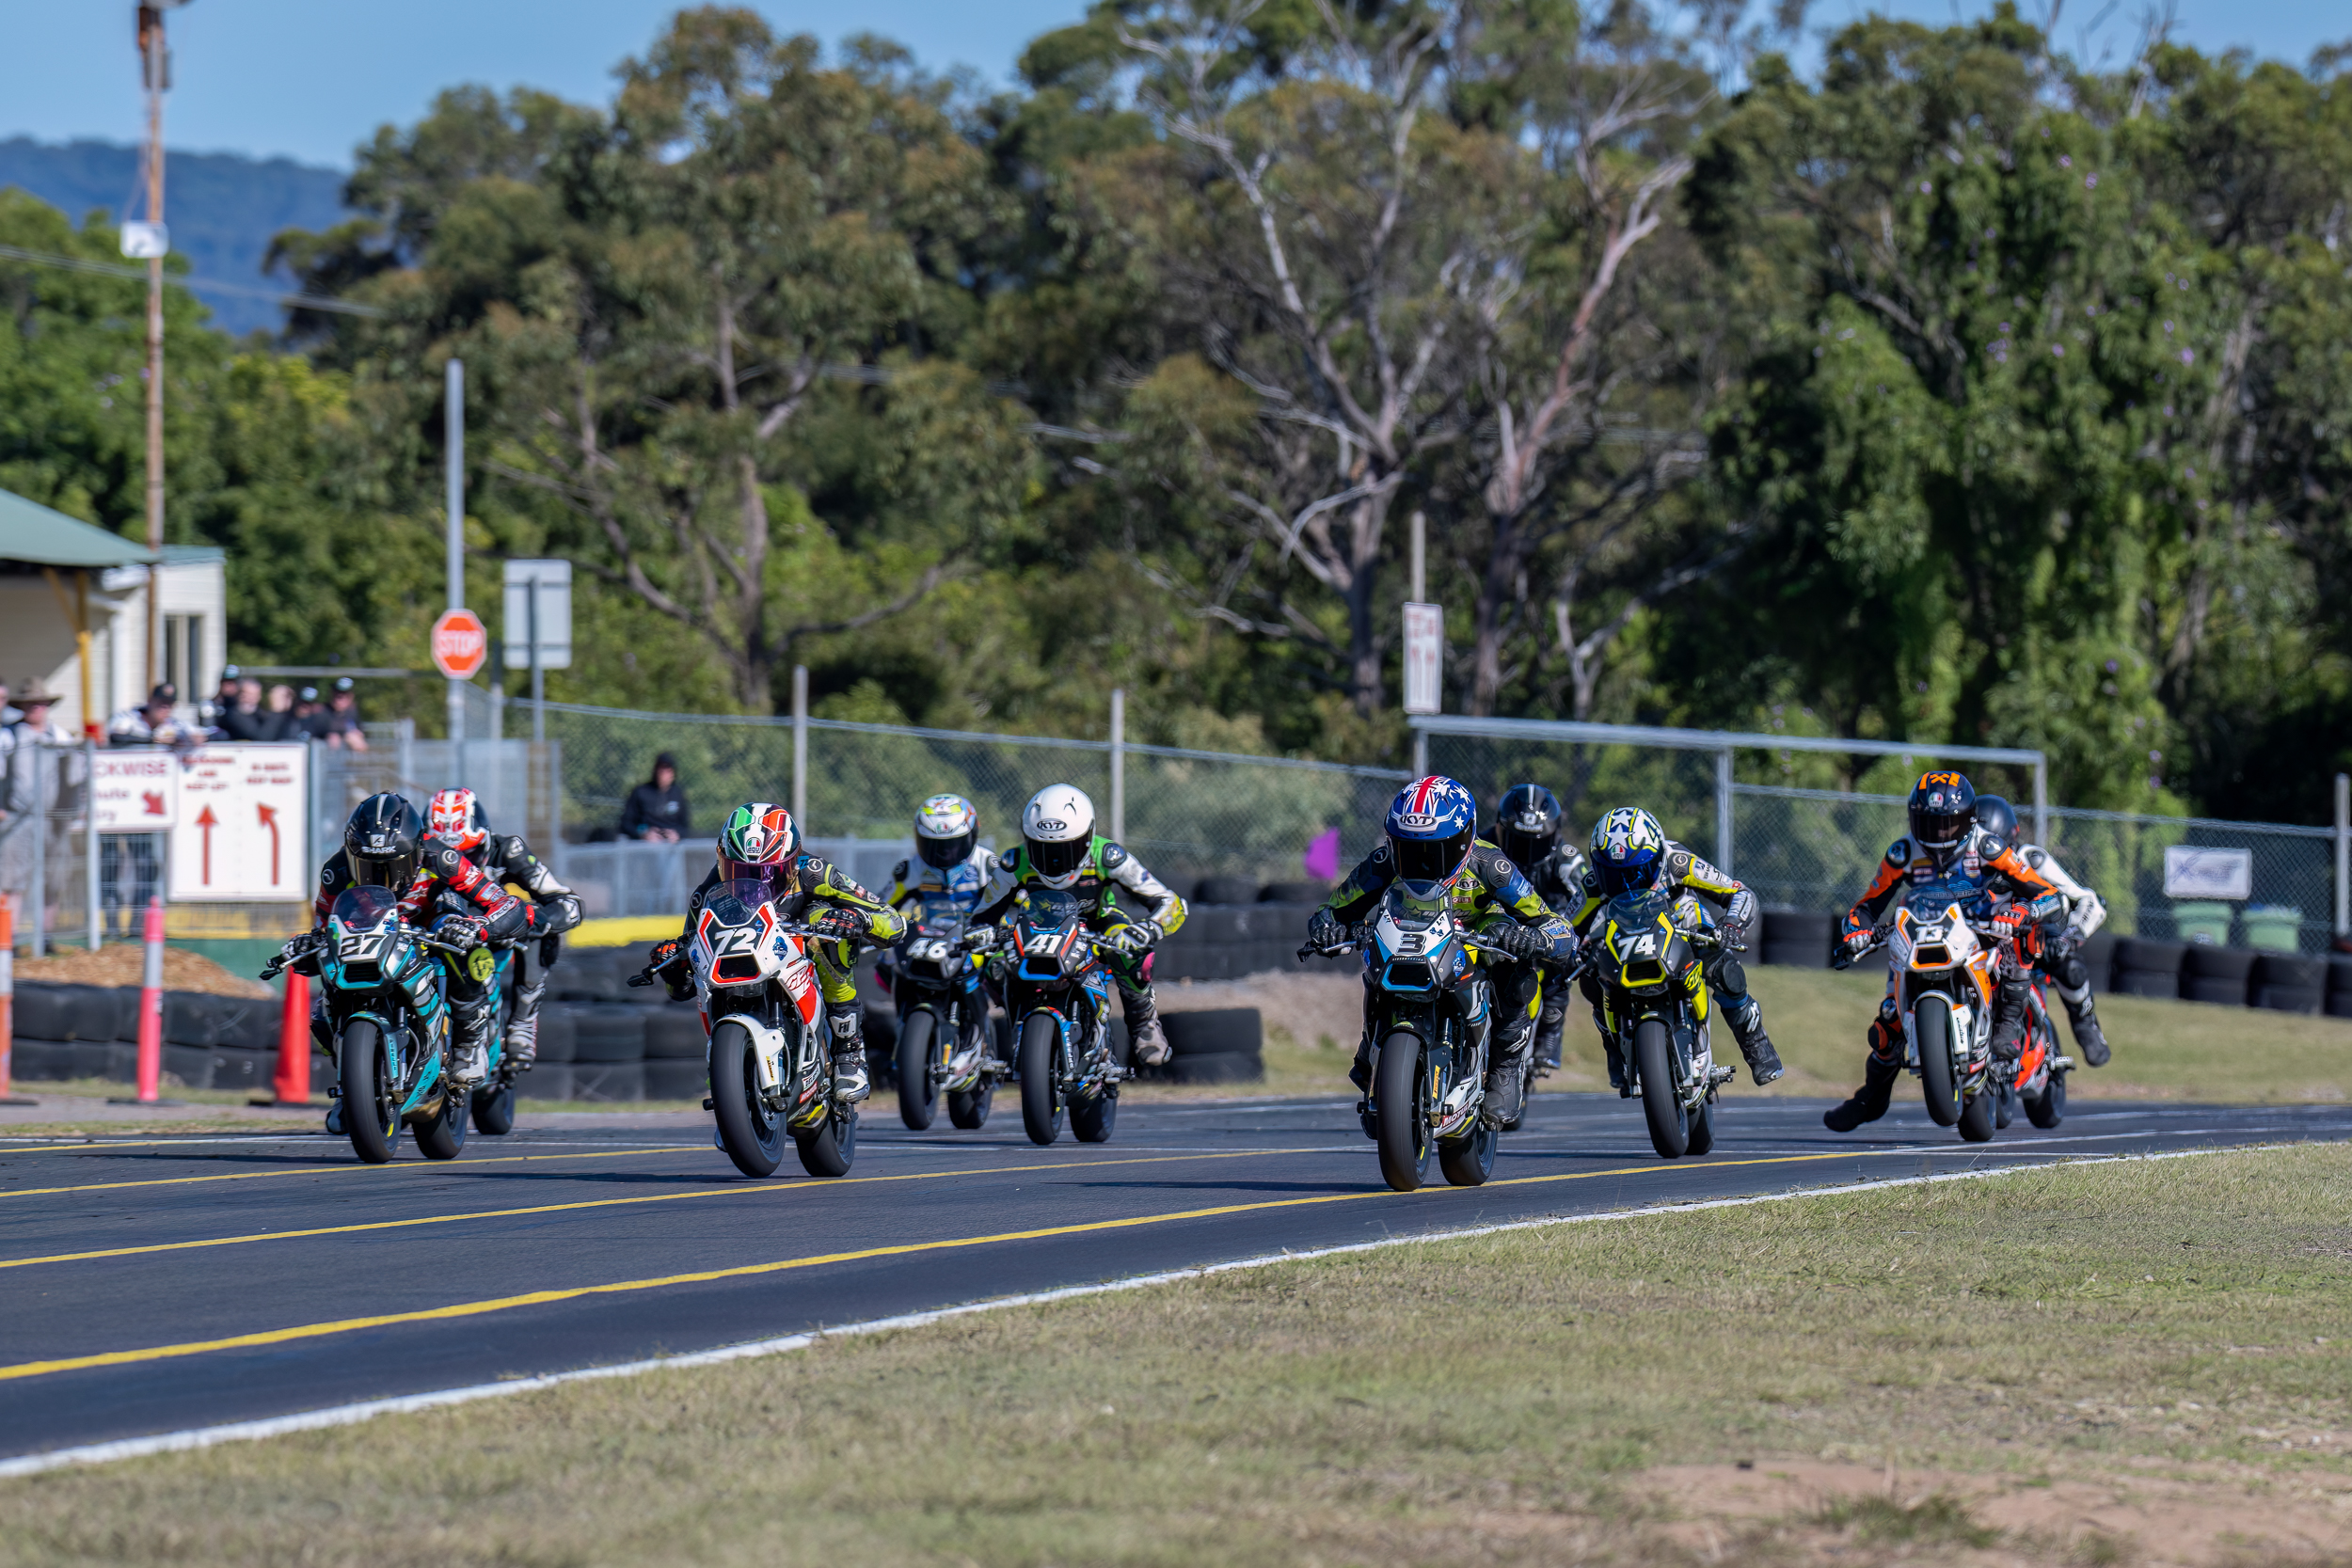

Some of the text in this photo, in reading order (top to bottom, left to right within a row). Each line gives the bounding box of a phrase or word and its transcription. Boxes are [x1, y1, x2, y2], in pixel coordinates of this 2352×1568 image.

[436, 631, 482, 657] STOP
[95, 759, 168, 776] CKWISE
[1038, 819, 1066, 831] KYT
[1402, 815, 1435, 826] KYT
[361, 846, 396, 854] SHARK
[715, 927, 756, 956] 72
[1023, 933, 1063, 954] 41
[1395, 933, 1427, 956] 3
[1915, 926, 1944, 942] 13
[341, 933, 389, 958] 27
[906, 937, 948, 959] 46
[1618, 933, 1657, 960] 74
[1442, 1103, 1469, 1128] MOTUL
